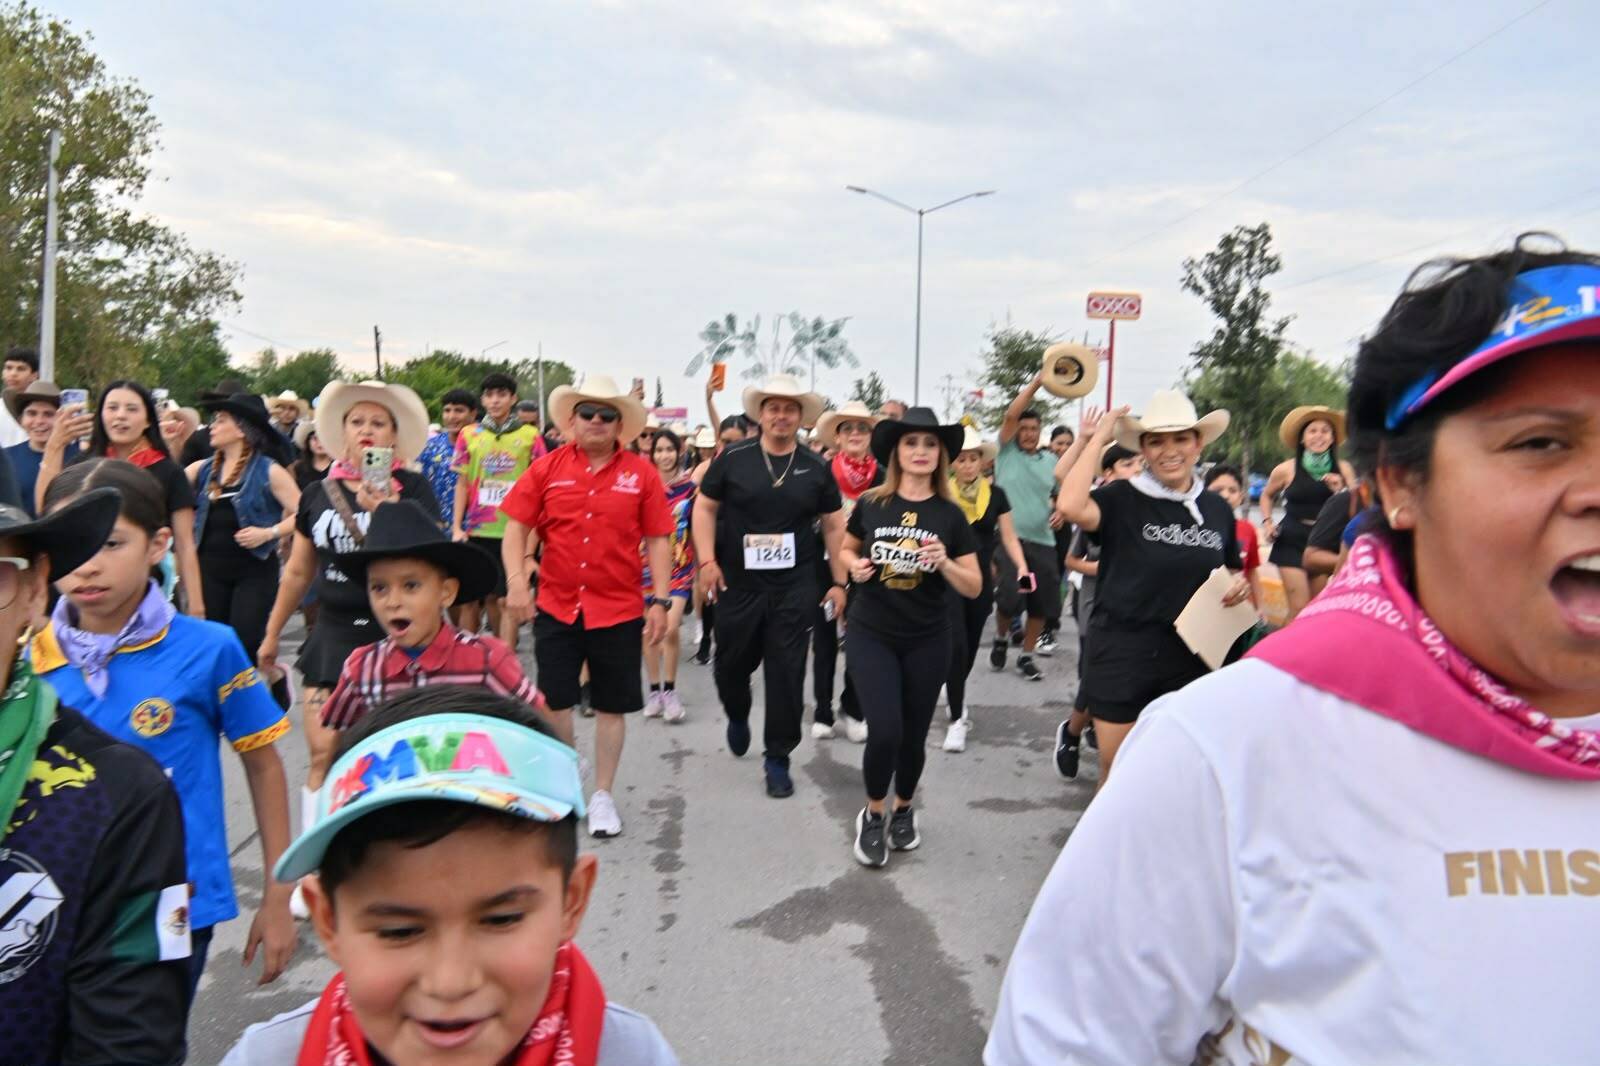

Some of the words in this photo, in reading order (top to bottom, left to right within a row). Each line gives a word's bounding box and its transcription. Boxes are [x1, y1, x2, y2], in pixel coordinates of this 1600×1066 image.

[1088, 296, 1140, 315] OXXO
[1142, 523, 1223, 551] adidas
[757, 547, 792, 561] 1242
